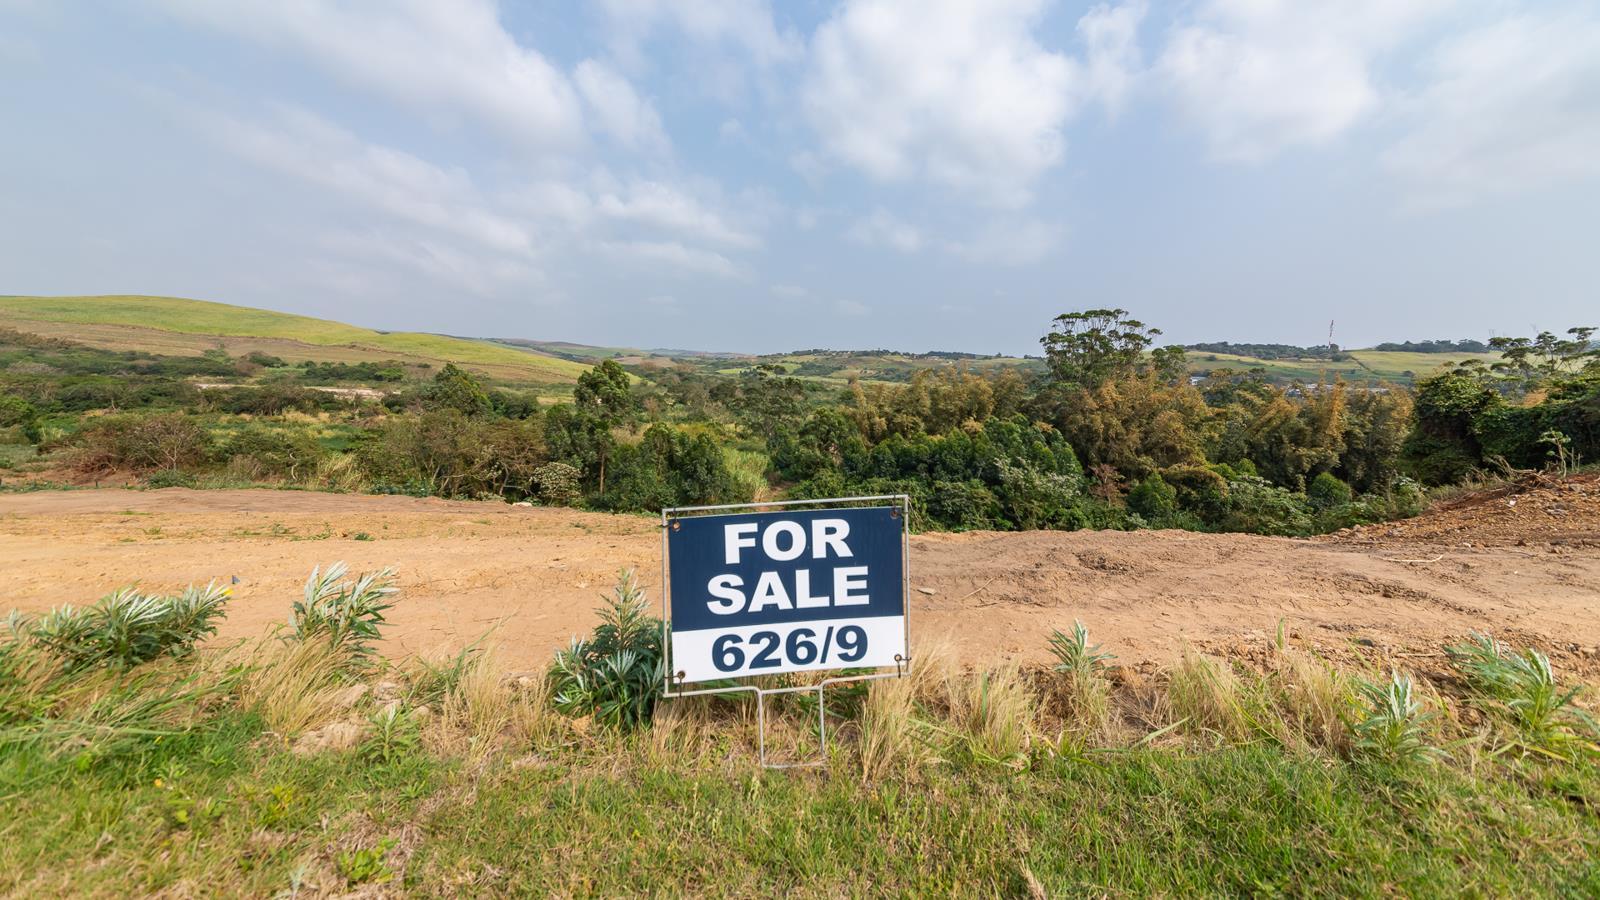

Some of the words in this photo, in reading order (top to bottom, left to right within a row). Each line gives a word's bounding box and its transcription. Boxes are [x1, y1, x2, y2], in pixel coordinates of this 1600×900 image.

[724, 518, 853, 565] FOR
[706, 566, 870, 615] SALE
[711, 625, 868, 672] 626/9
